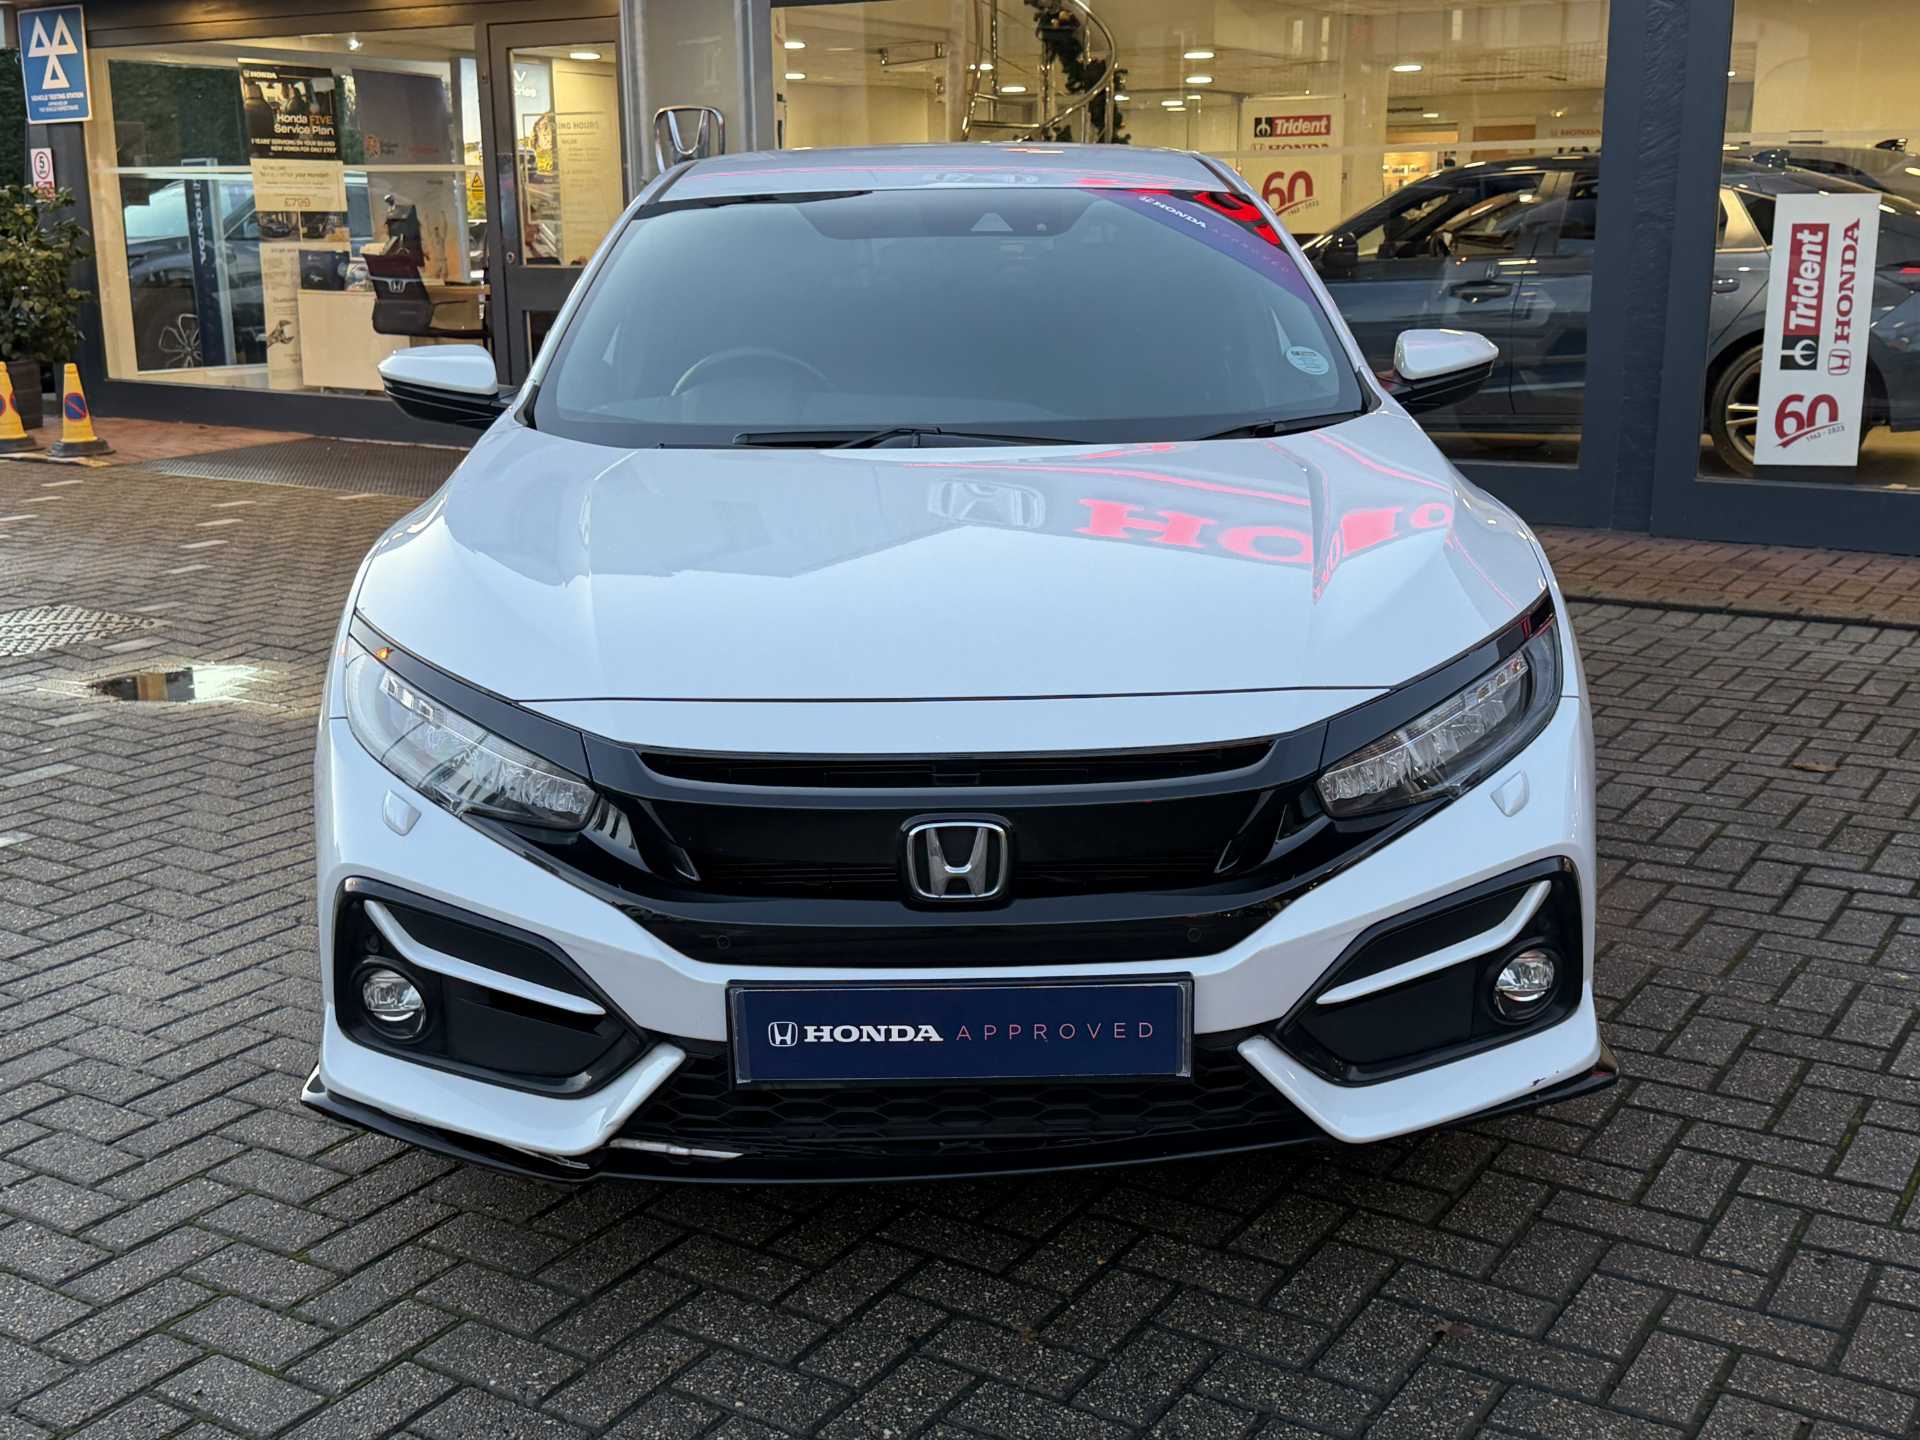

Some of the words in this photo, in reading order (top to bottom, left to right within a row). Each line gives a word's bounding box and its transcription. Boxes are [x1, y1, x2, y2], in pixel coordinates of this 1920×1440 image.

[274, 124, 311, 134] Service
[312, 127, 335, 136] Plan
[276, 113, 308, 124] Honda
[309, 115, 333, 125] FIVE
[1274, 117, 1328, 135] Trident
[39, 156, 45, 169] 5
[1262, 171, 1313, 208] 60
[194, 192, 207, 265] HONDA
[1153, 200, 1207, 229] HONDA
[1788, 228, 1825, 332] Trident
[1833, 218, 1861, 345] HONDA
[1774, 393, 1839, 441] 60
[803, 1025, 944, 1042] HONDA
[956, 1022, 1154, 1042] APPROVED
